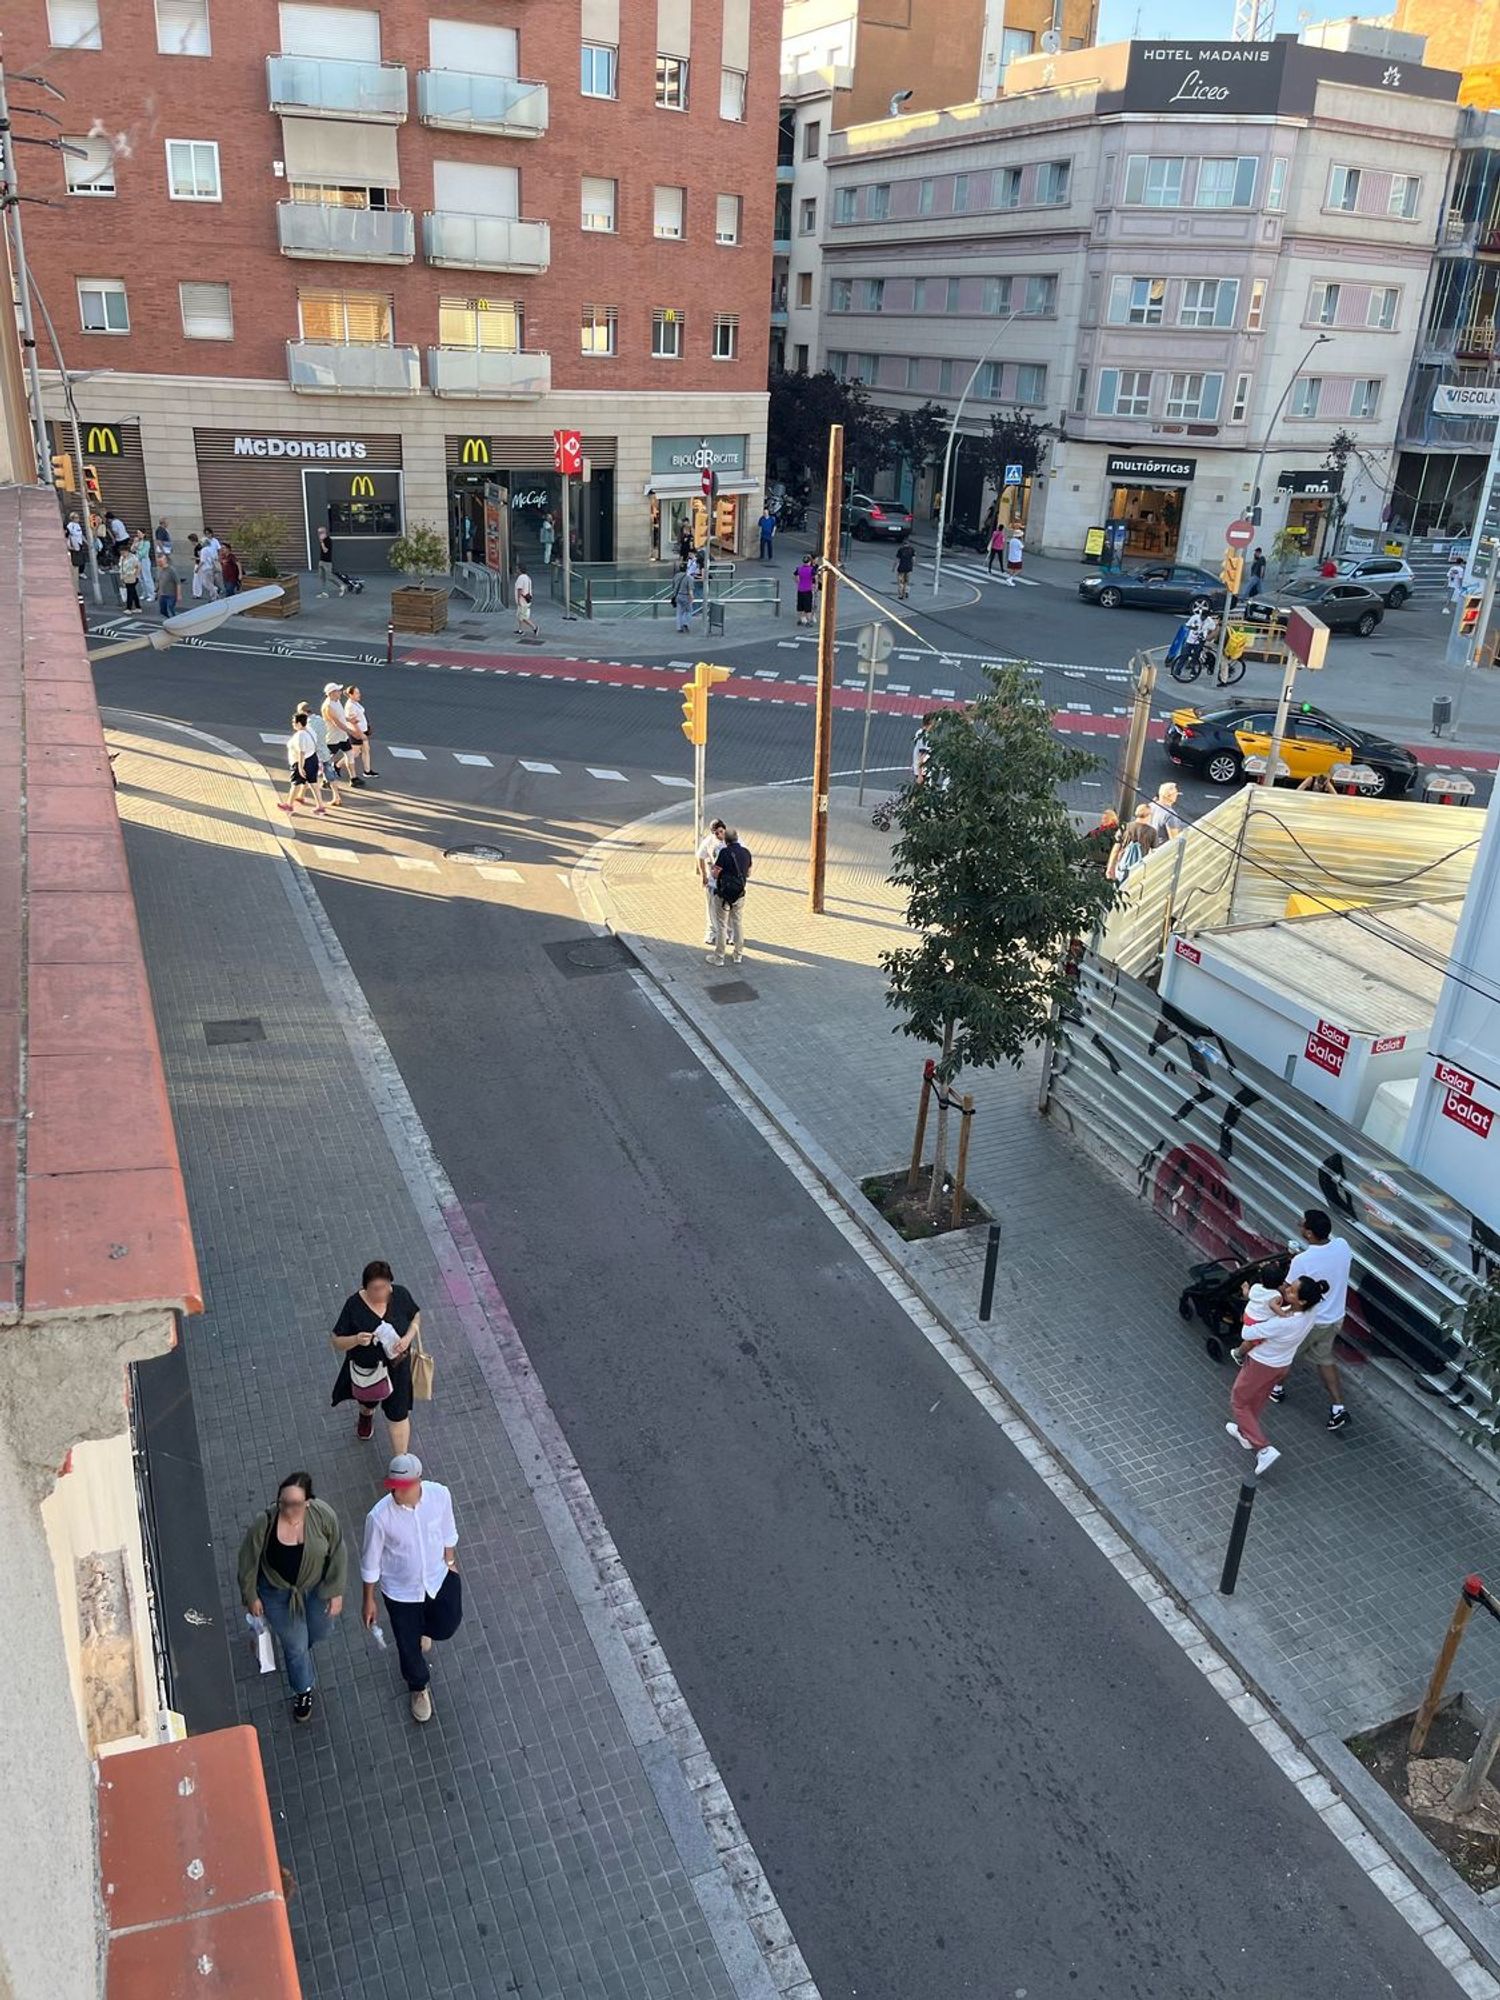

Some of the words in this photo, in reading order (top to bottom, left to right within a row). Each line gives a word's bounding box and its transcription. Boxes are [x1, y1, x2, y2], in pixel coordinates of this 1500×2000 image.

[1144, 50, 1193, 60] HOTEL
[1199, 50, 1270, 61] MADANIS
[1169, 70, 1230, 103] Liceo
[1447, 390, 1496, 404] VISCOLA
[234, 437, 367, 458] McDonald's
[1178, 942, 1198, 961] balat
[1321, 1023, 1345, 1045] balat
[1308, 1035, 1342, 1069] balat
[1376, 1040, 1401, 1052] balat
[1440, 1065, 1469, 1092] balat
[1447, 1090, 1490, 1130] balat
